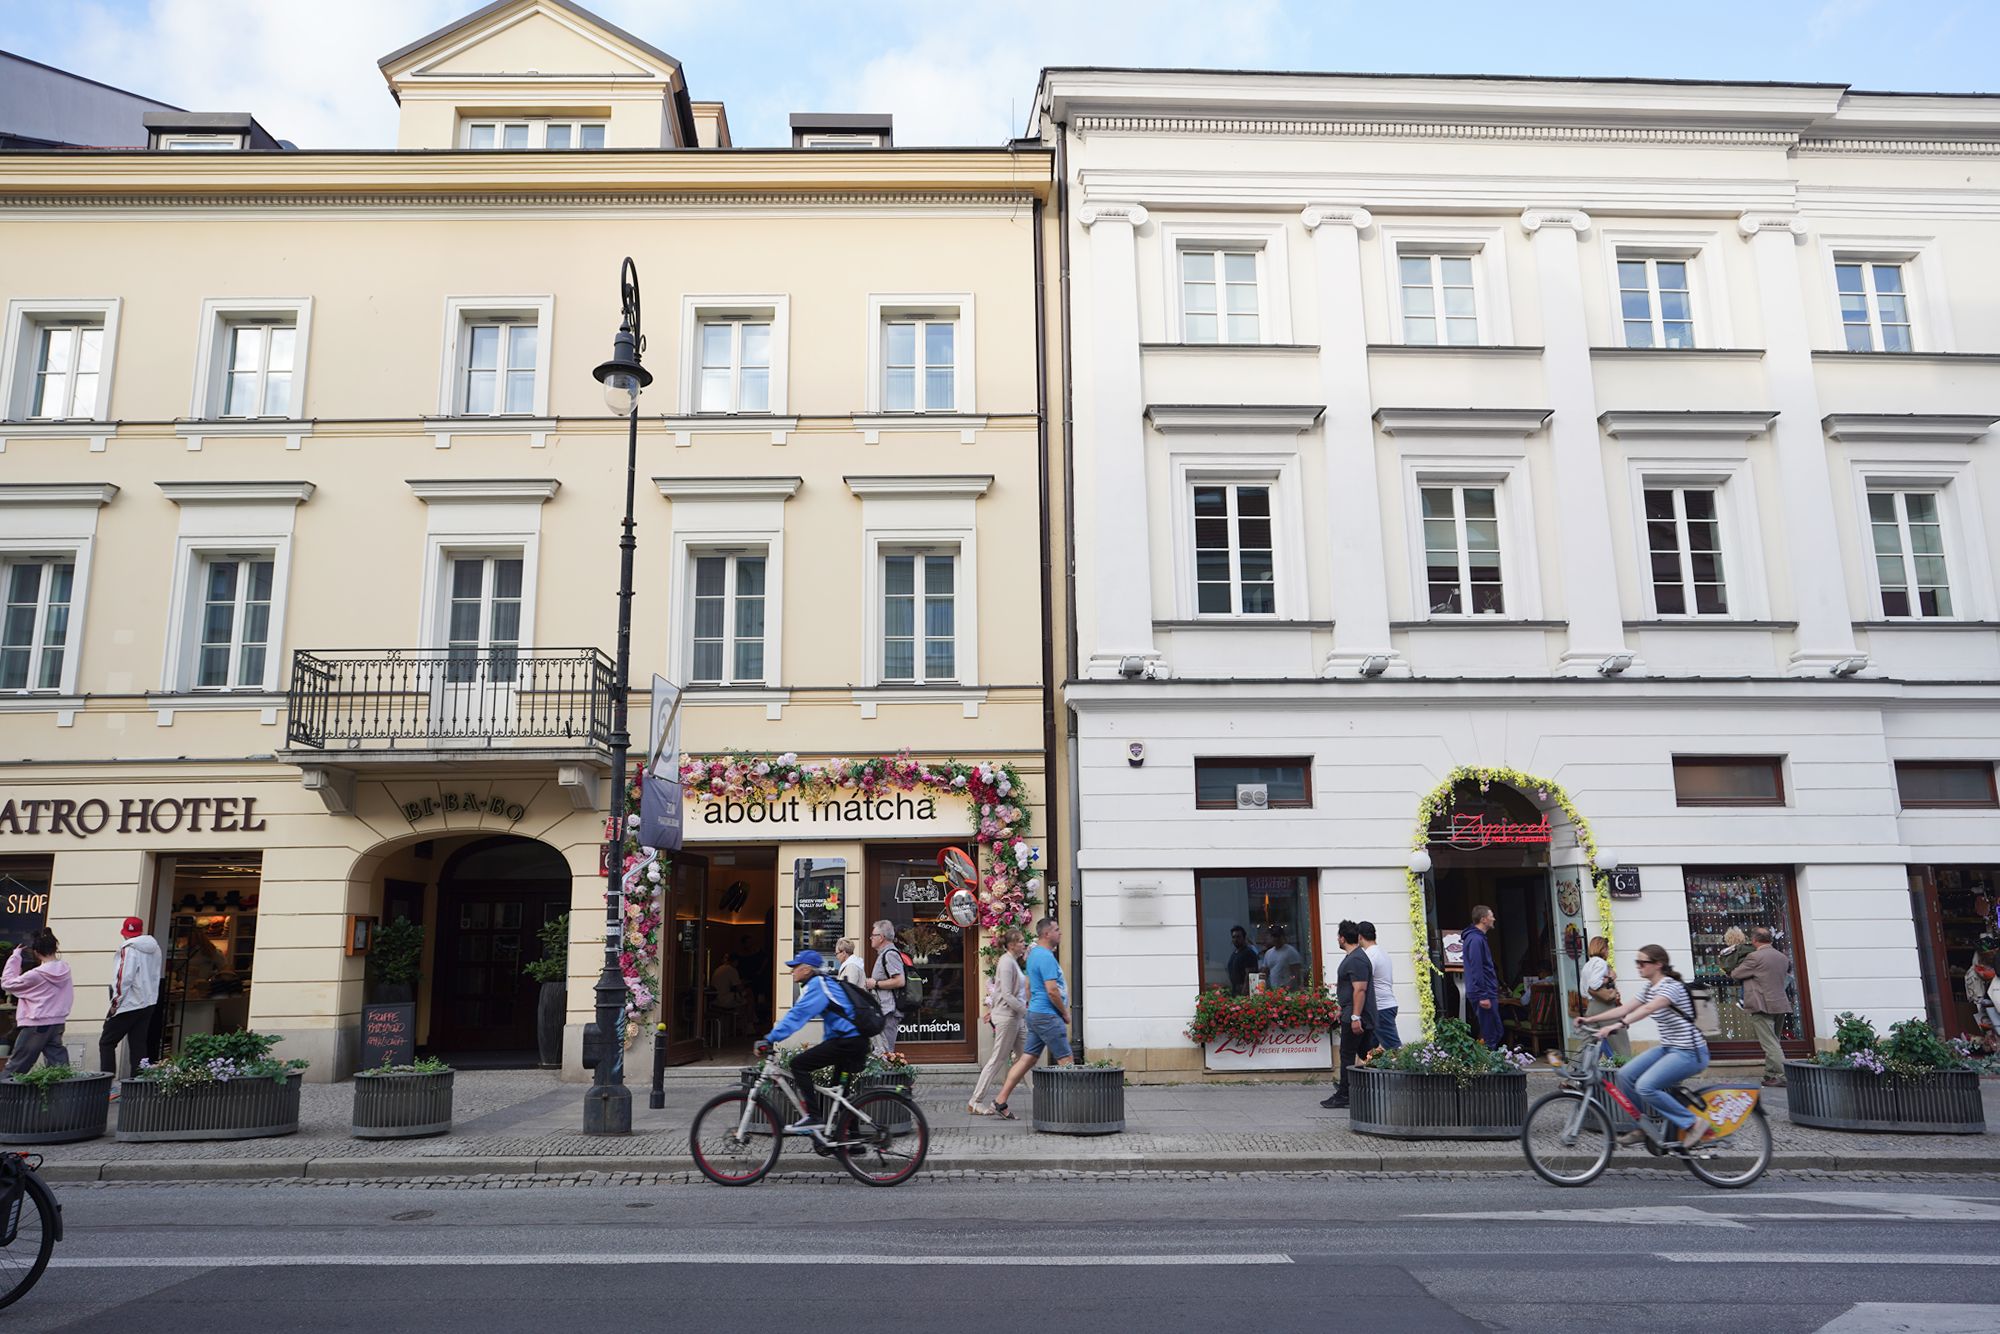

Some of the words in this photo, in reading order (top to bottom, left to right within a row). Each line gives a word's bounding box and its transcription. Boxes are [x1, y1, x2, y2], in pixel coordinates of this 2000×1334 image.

[116, 797, 267, 834] HOTEL
[704, 796, 800, 824] about
[1451, 813, 1553, 846] Zapiecek
[896, 1023, 918, 1033] out
[919, 1018, 961, 1032] mátcha
[1214, 1027, 1321, 1058] Ziecek
